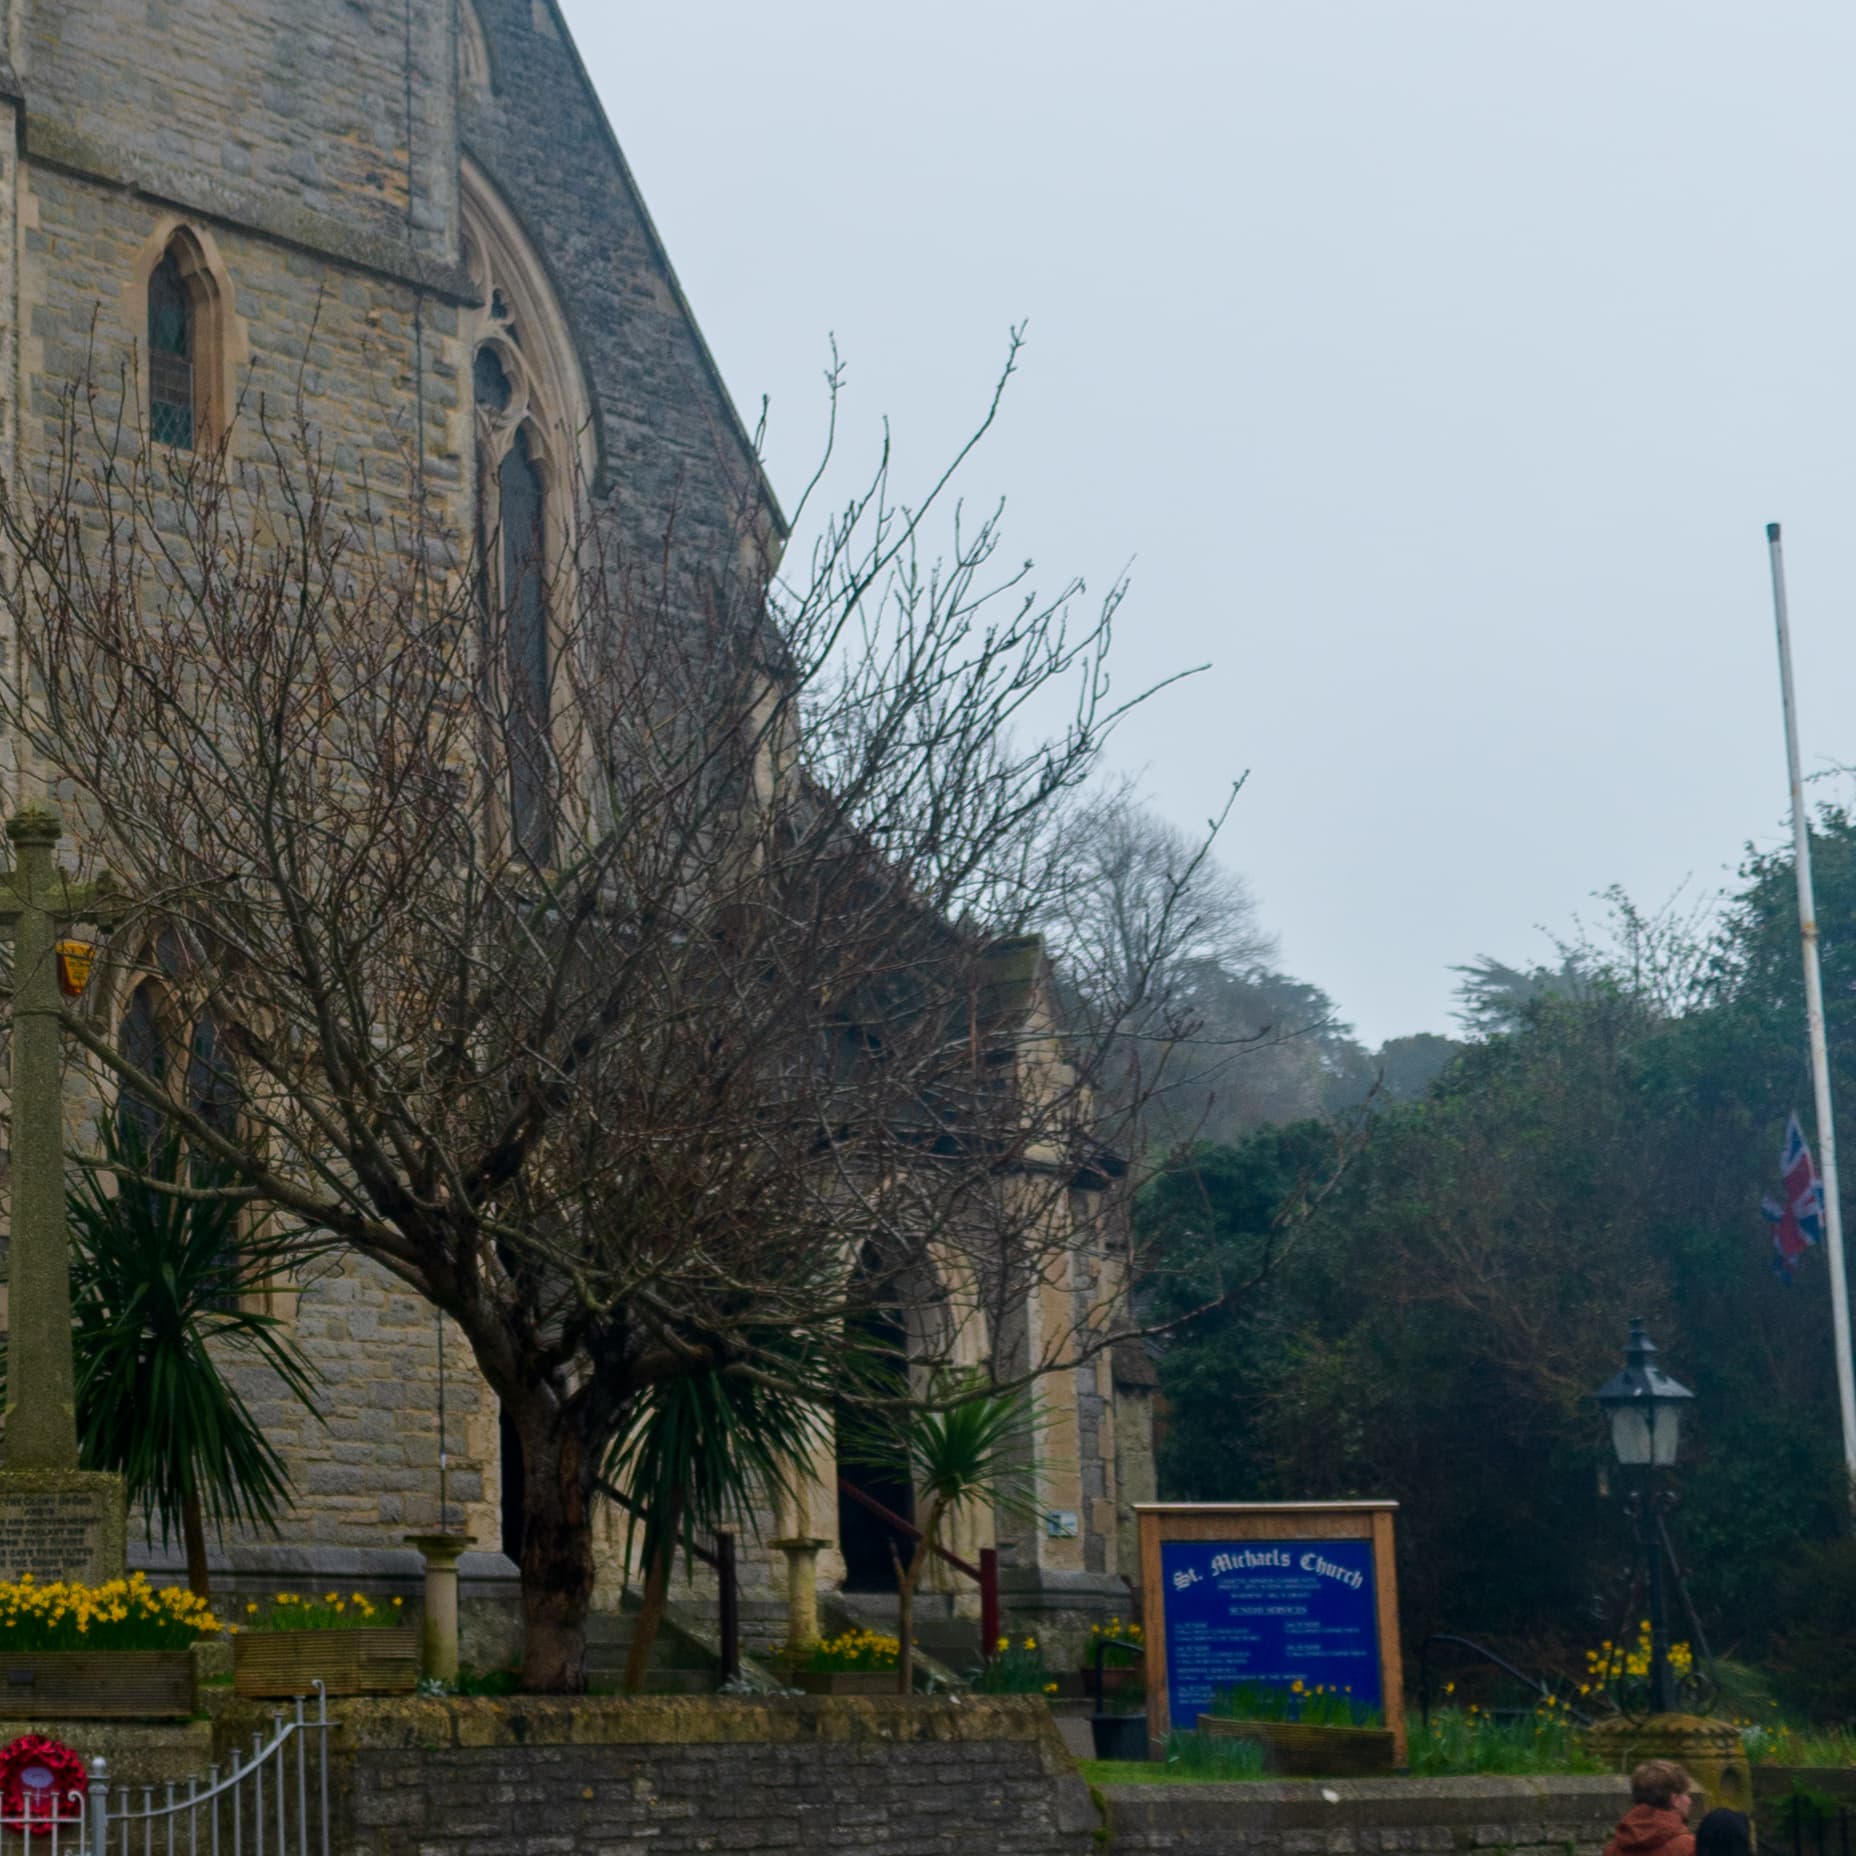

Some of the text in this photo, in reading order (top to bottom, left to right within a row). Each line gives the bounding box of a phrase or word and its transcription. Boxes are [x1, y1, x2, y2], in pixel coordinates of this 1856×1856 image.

[1173, 1549, 1364, 1591] St. Michaels Church
